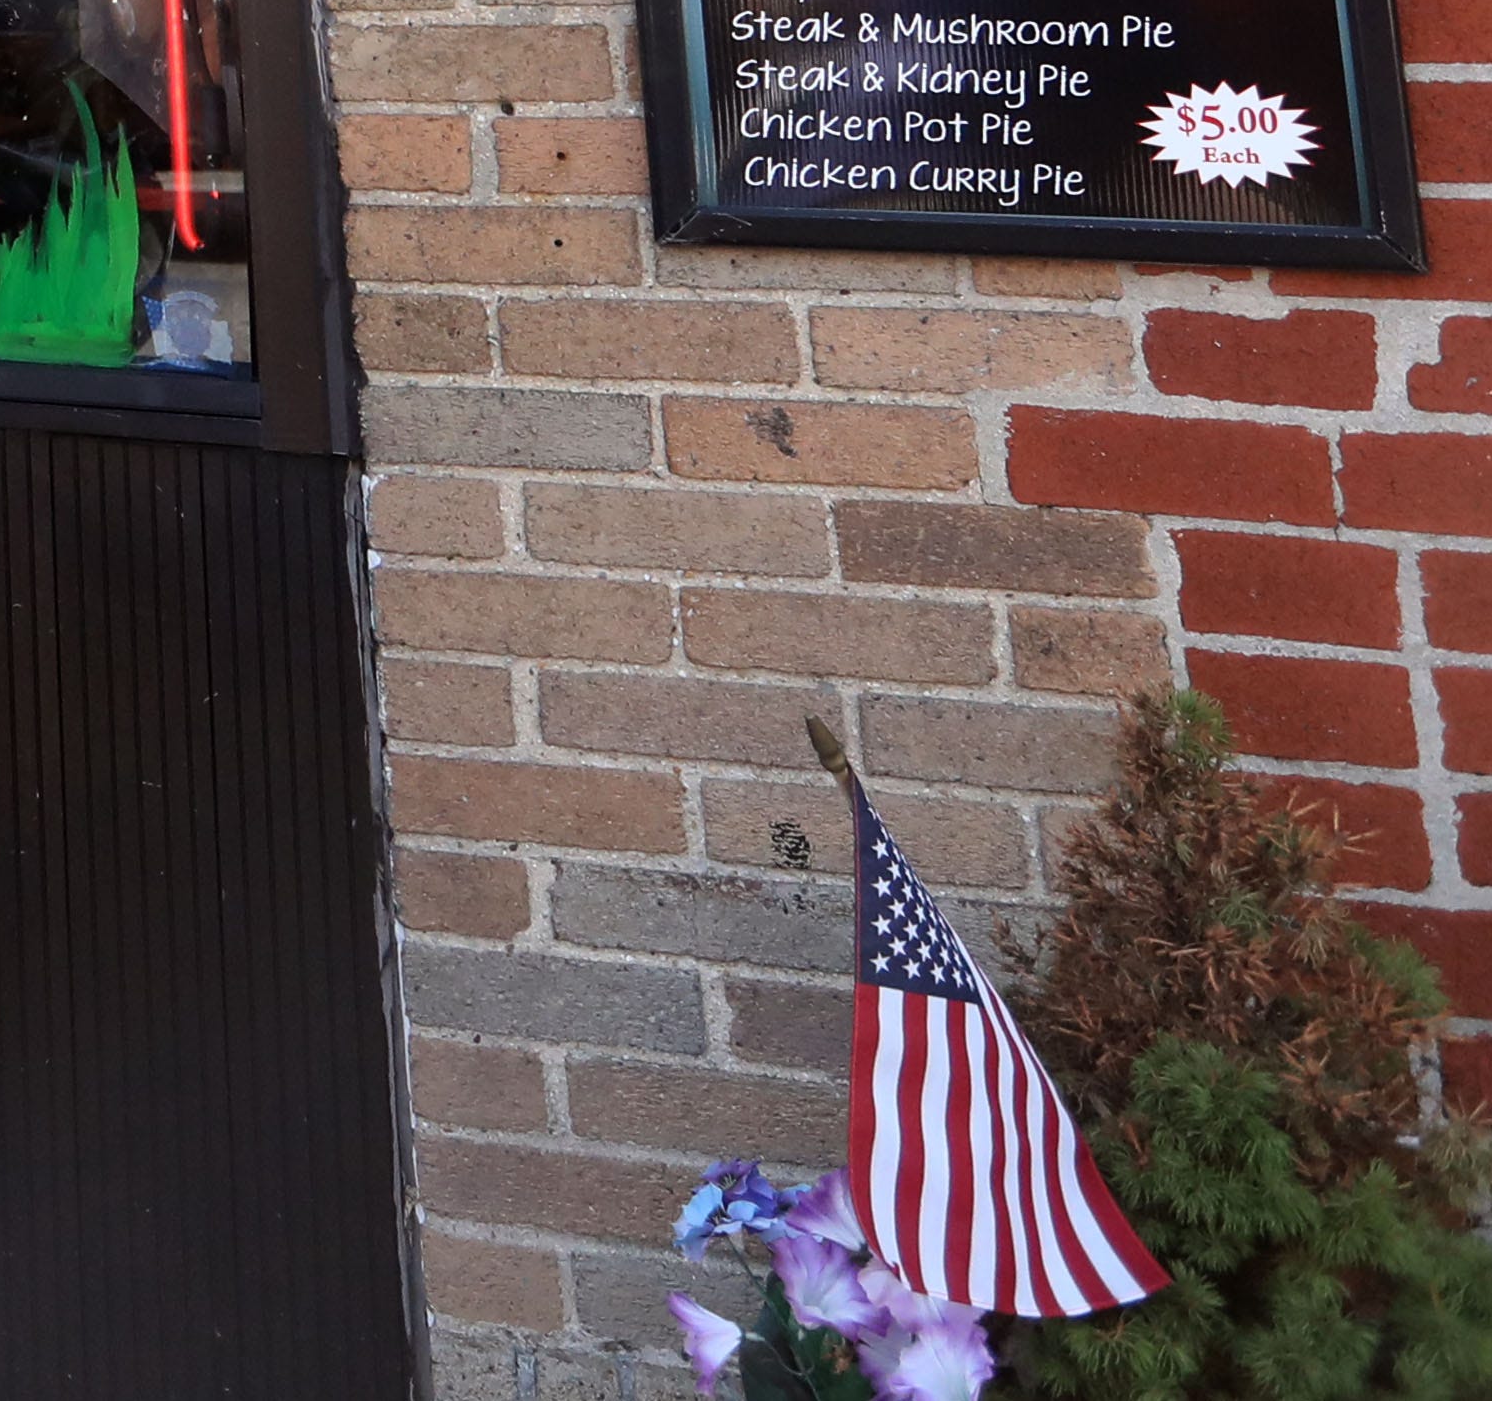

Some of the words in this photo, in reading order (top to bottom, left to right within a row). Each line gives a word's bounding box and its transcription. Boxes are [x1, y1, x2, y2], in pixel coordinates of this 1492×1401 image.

[731, 12, 846, 44] Steak
[858, 15, 879, 43] &
[1122, 15, 1176, 48] Pie
[736, 61, 850, 93] Steak
[862, 64, 884, 92] &
[896, 62, 1028, 106] Kidney
[1038, 64, 1092, 97] Pie
[740, 108, 892, 142] Chicken
[904, 112, 968, 143] Pot
[981, 112, 1035, 146] Pie
[1177, 104, 1279, 141] $5.00
[1202, 146, 1260, 165] Each
[744, 157, 896, 191] Chicken
[1033, 163, 1086, 197] Pie
